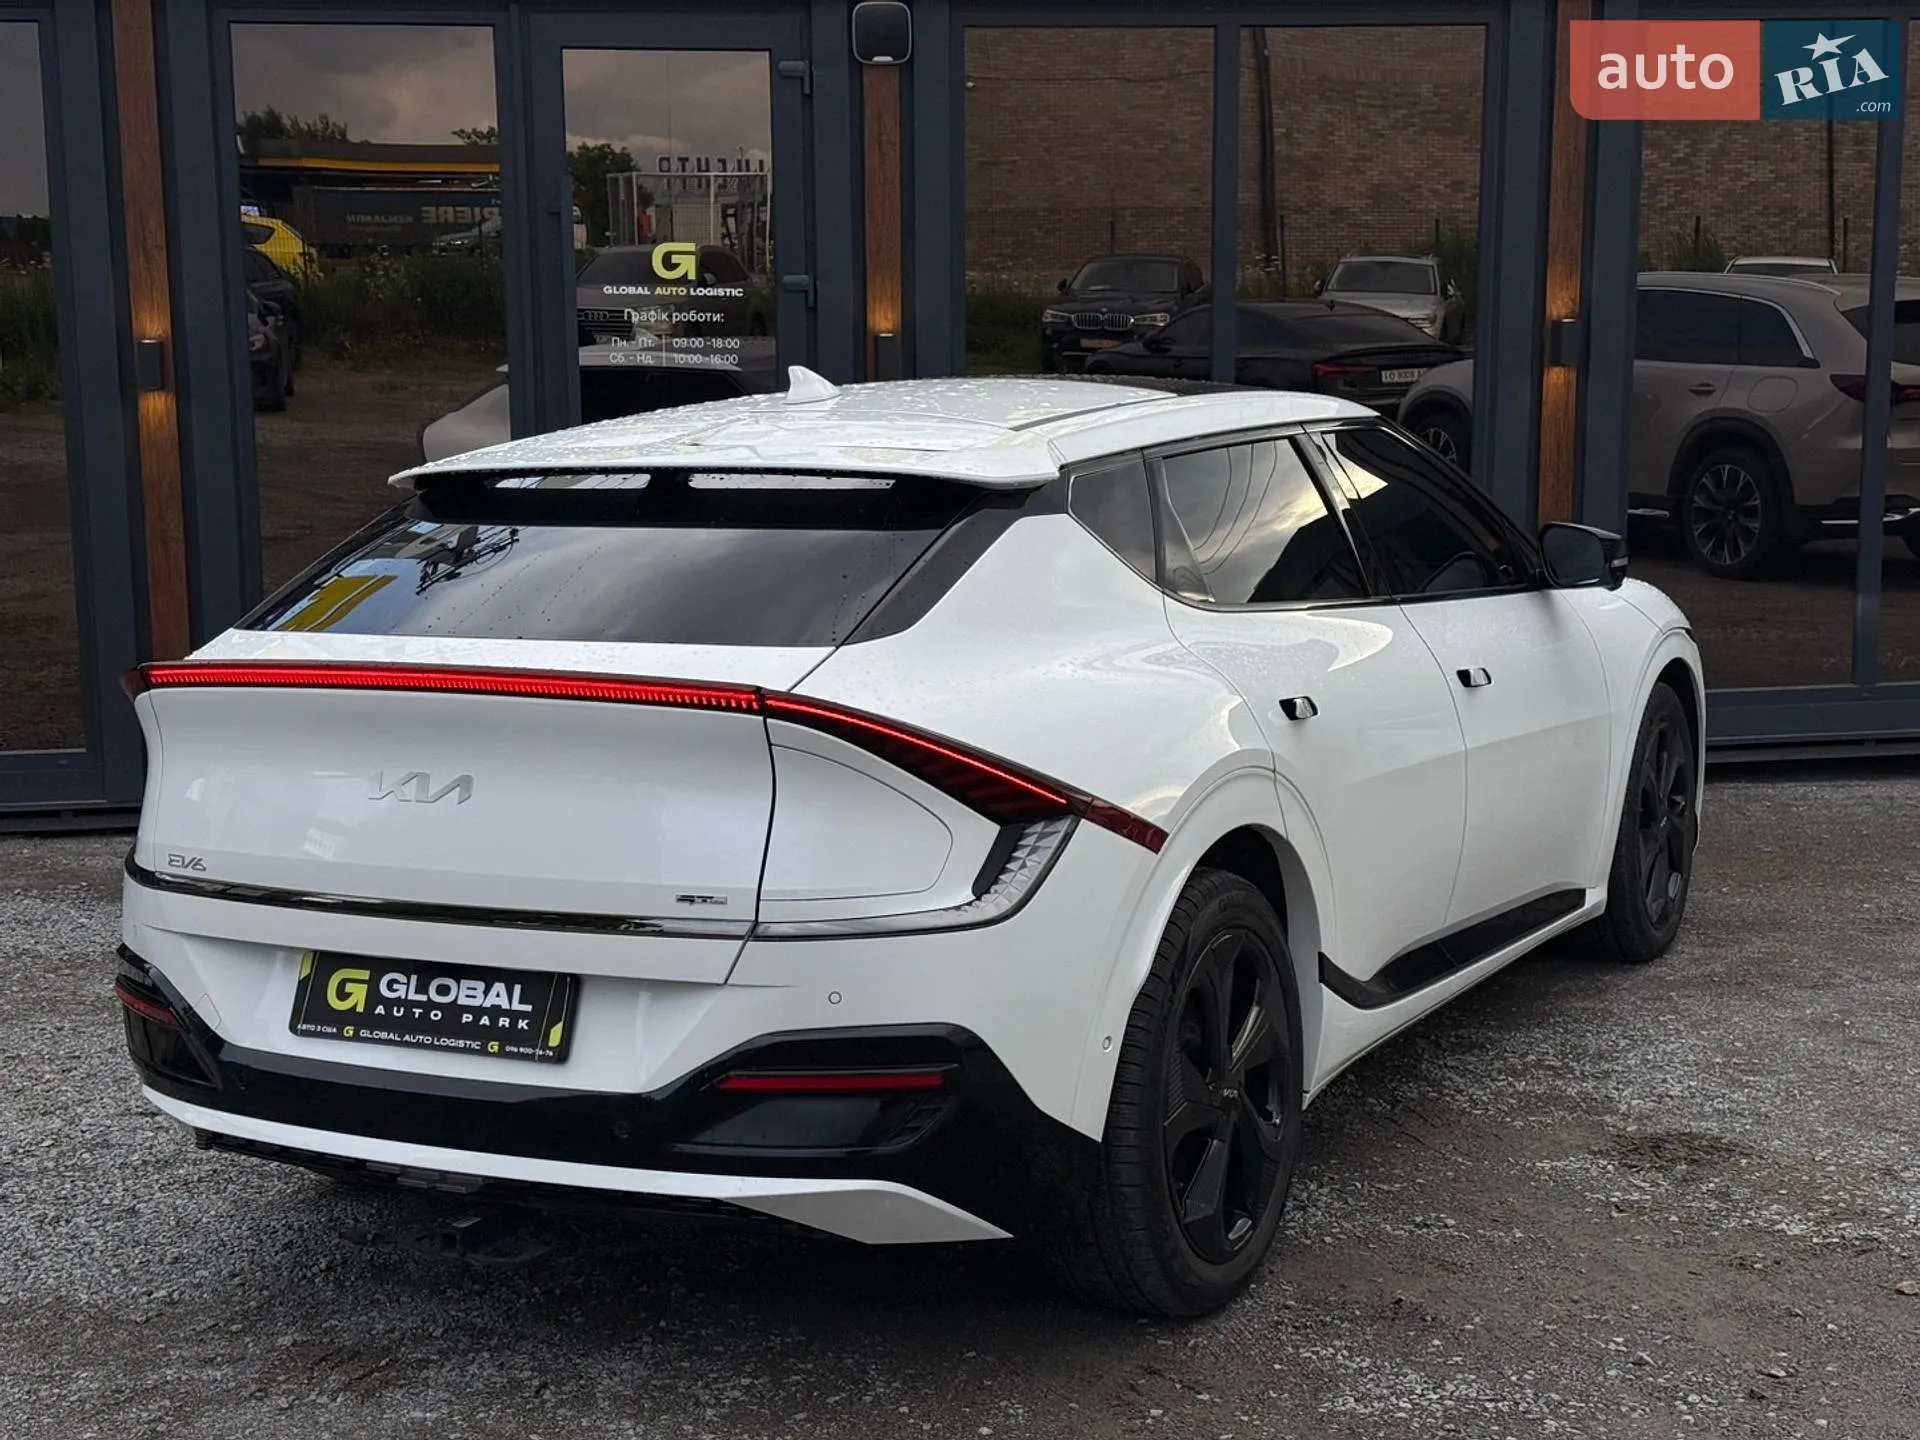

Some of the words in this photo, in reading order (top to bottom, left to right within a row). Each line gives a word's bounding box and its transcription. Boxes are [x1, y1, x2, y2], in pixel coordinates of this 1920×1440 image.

[603, 285, 650, 295] GLOBAL
[654, 286, 687, 296] AUTO
[690, 287, 745, 297] LOGISTIC
[624, 308, 669, 324] Графік
[672, 309, 725, 324] роботи:
[167, 852, 207, 872] EV6
[378, 971, 533, 1012] GLOBAL
[374, 1004, 443, 1021] AUTO
[461, 1013, 530, 1030] PARK
[359, 1029, 402, 1041] GLOBAL
[402, 1033, 434, 1045] AUTO
[433, 1036, 482, 1050] LOGISTIC
